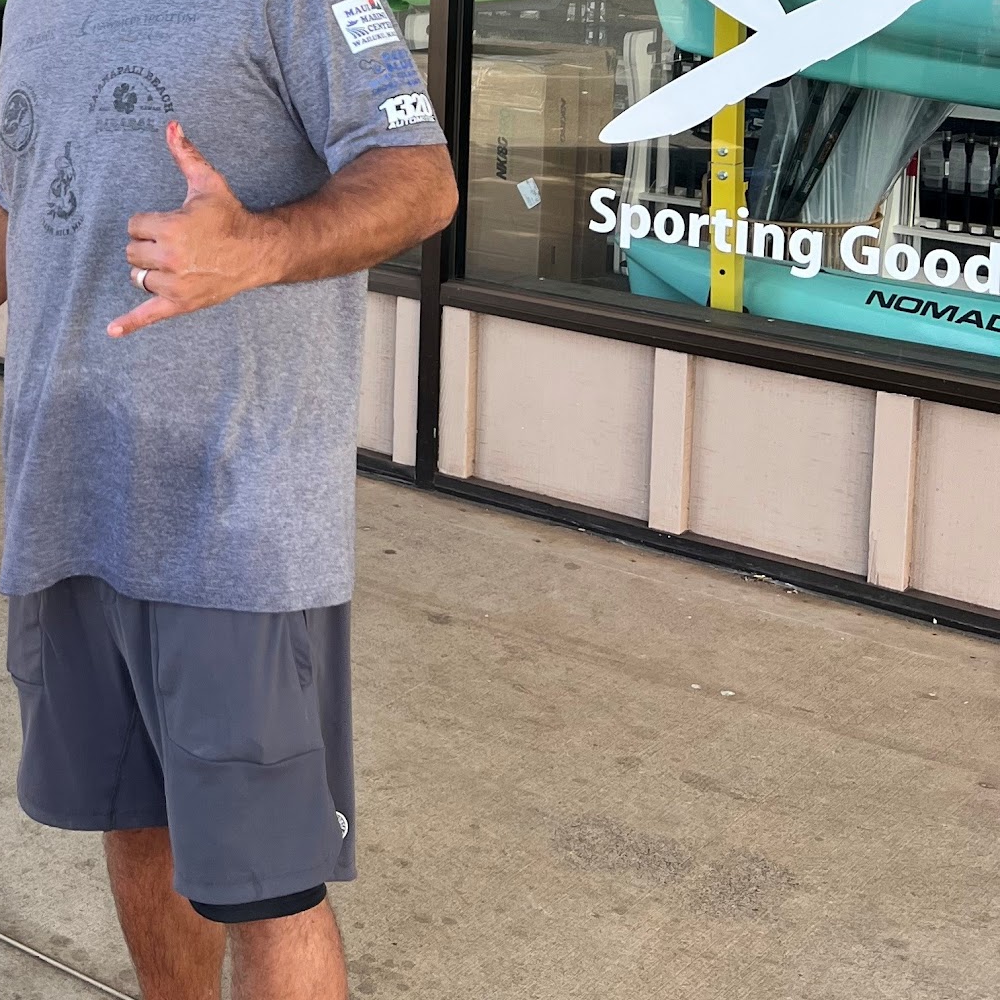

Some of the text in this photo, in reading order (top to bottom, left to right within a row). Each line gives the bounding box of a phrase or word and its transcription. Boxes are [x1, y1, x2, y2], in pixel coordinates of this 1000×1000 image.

[143, 70, 174, 114] BEACH
[378, 92, 435, 121] 1320
[588, 187, 1000, 296] Sporting Good
